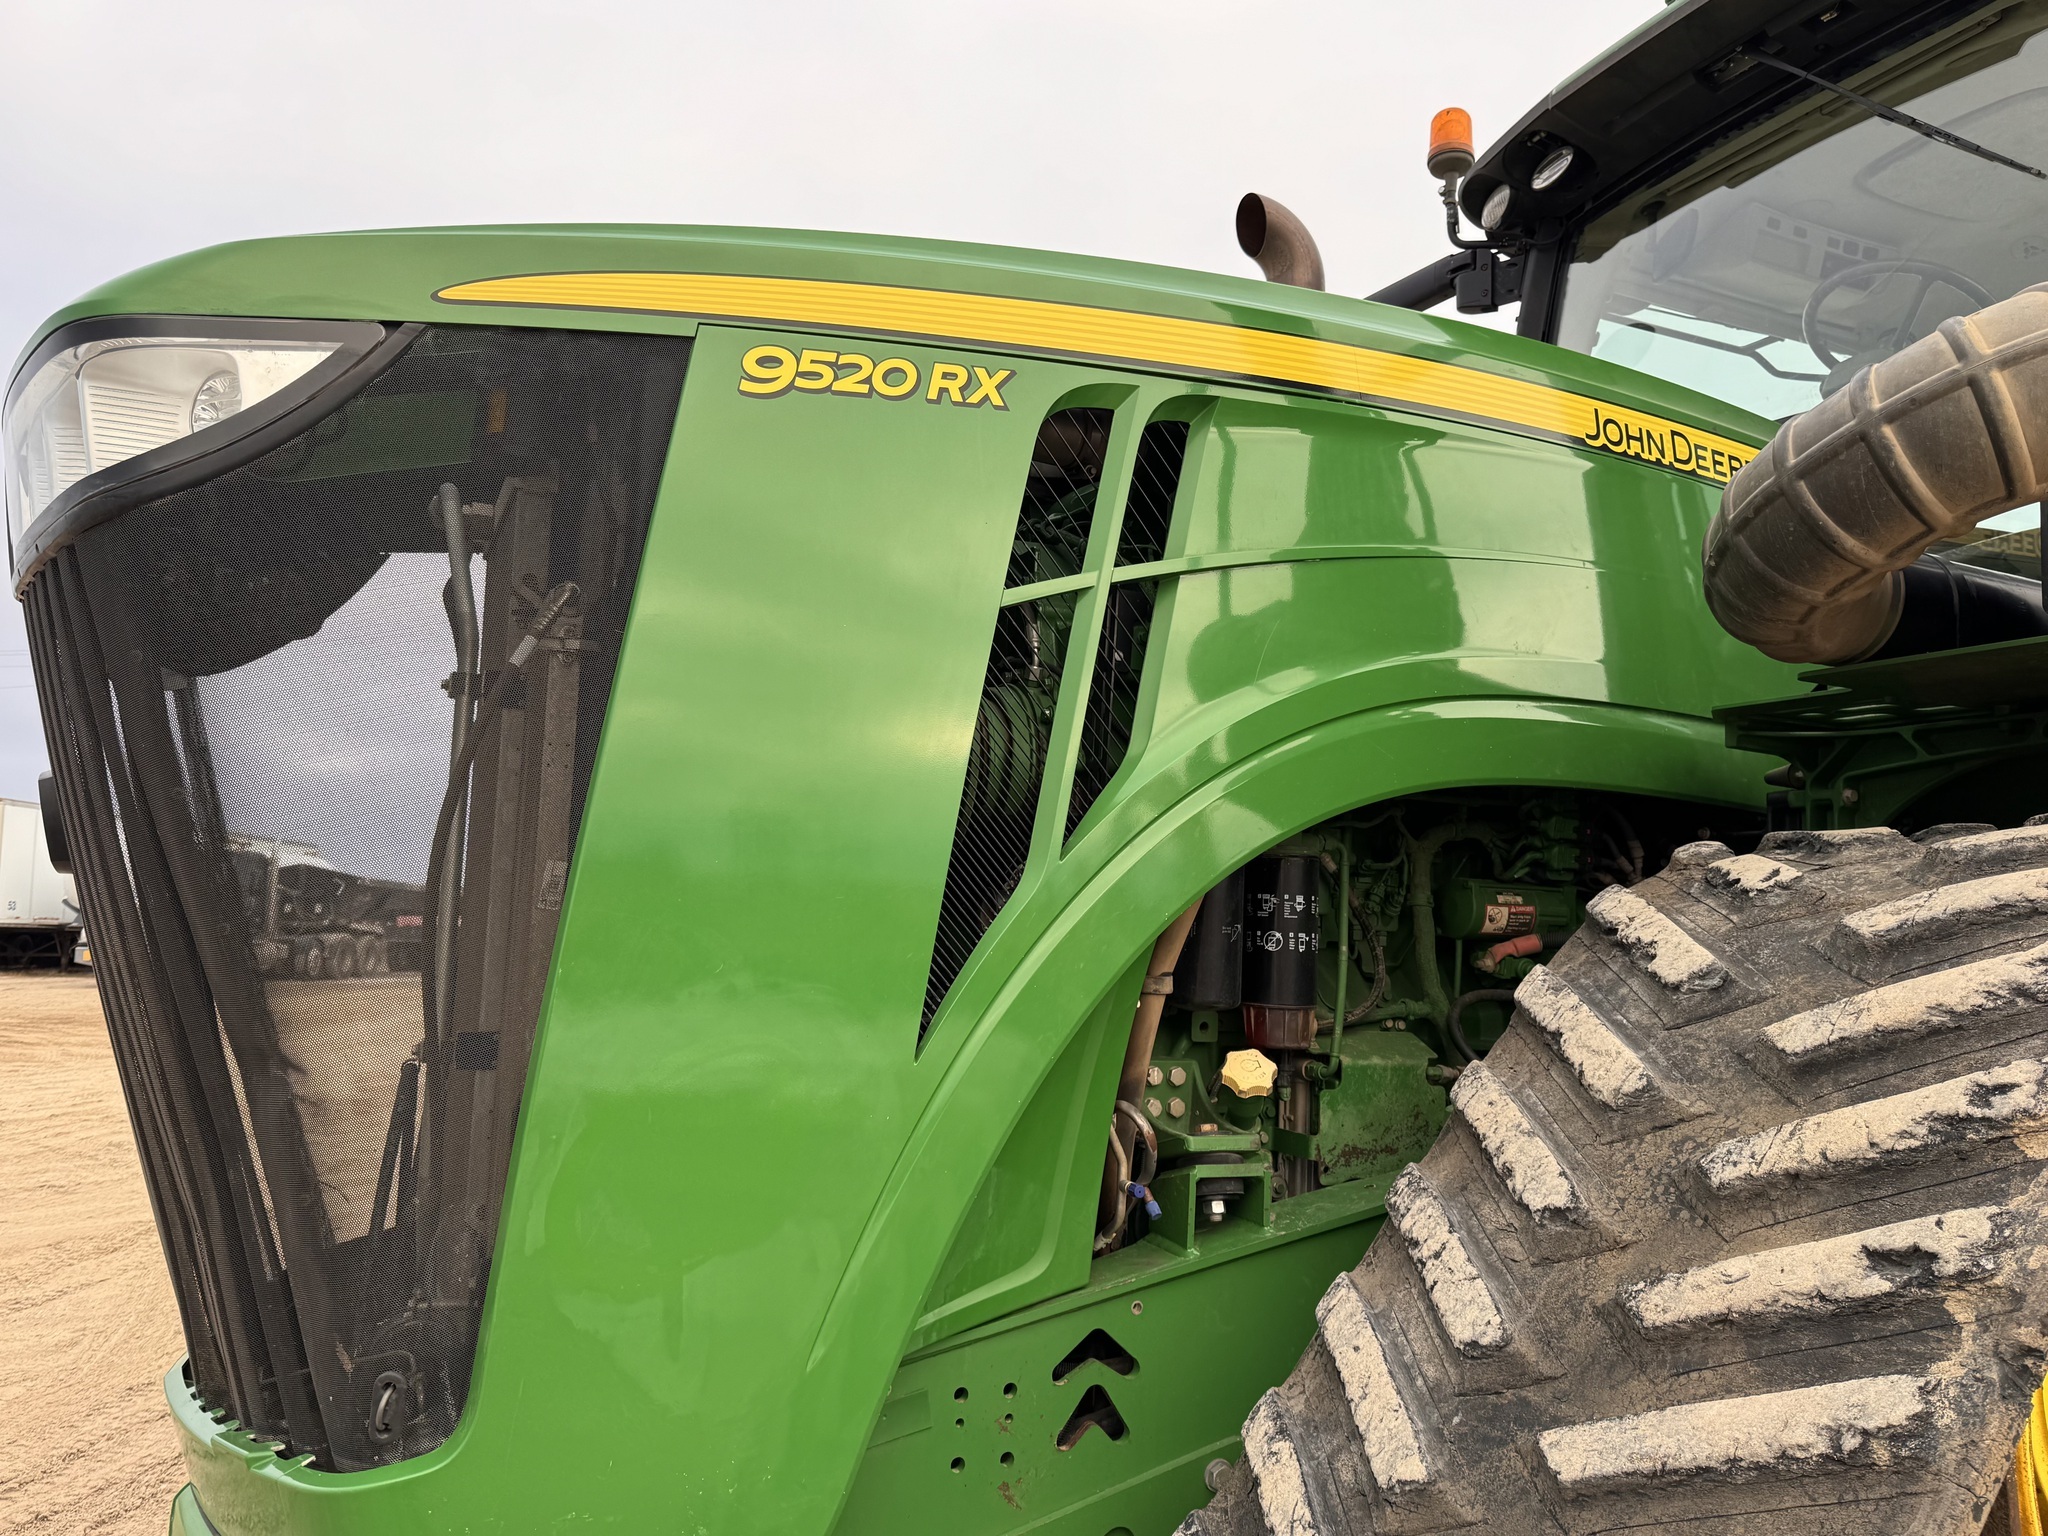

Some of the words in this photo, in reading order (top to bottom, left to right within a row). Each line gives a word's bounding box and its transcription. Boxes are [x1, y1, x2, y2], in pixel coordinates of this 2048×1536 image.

[738, 344, 921, 401] 9520
[925, 362, 1017, 411] RX
[1585, 407, 1668, 464] JOHN
[1670, 428, 1750, 480] DEER
